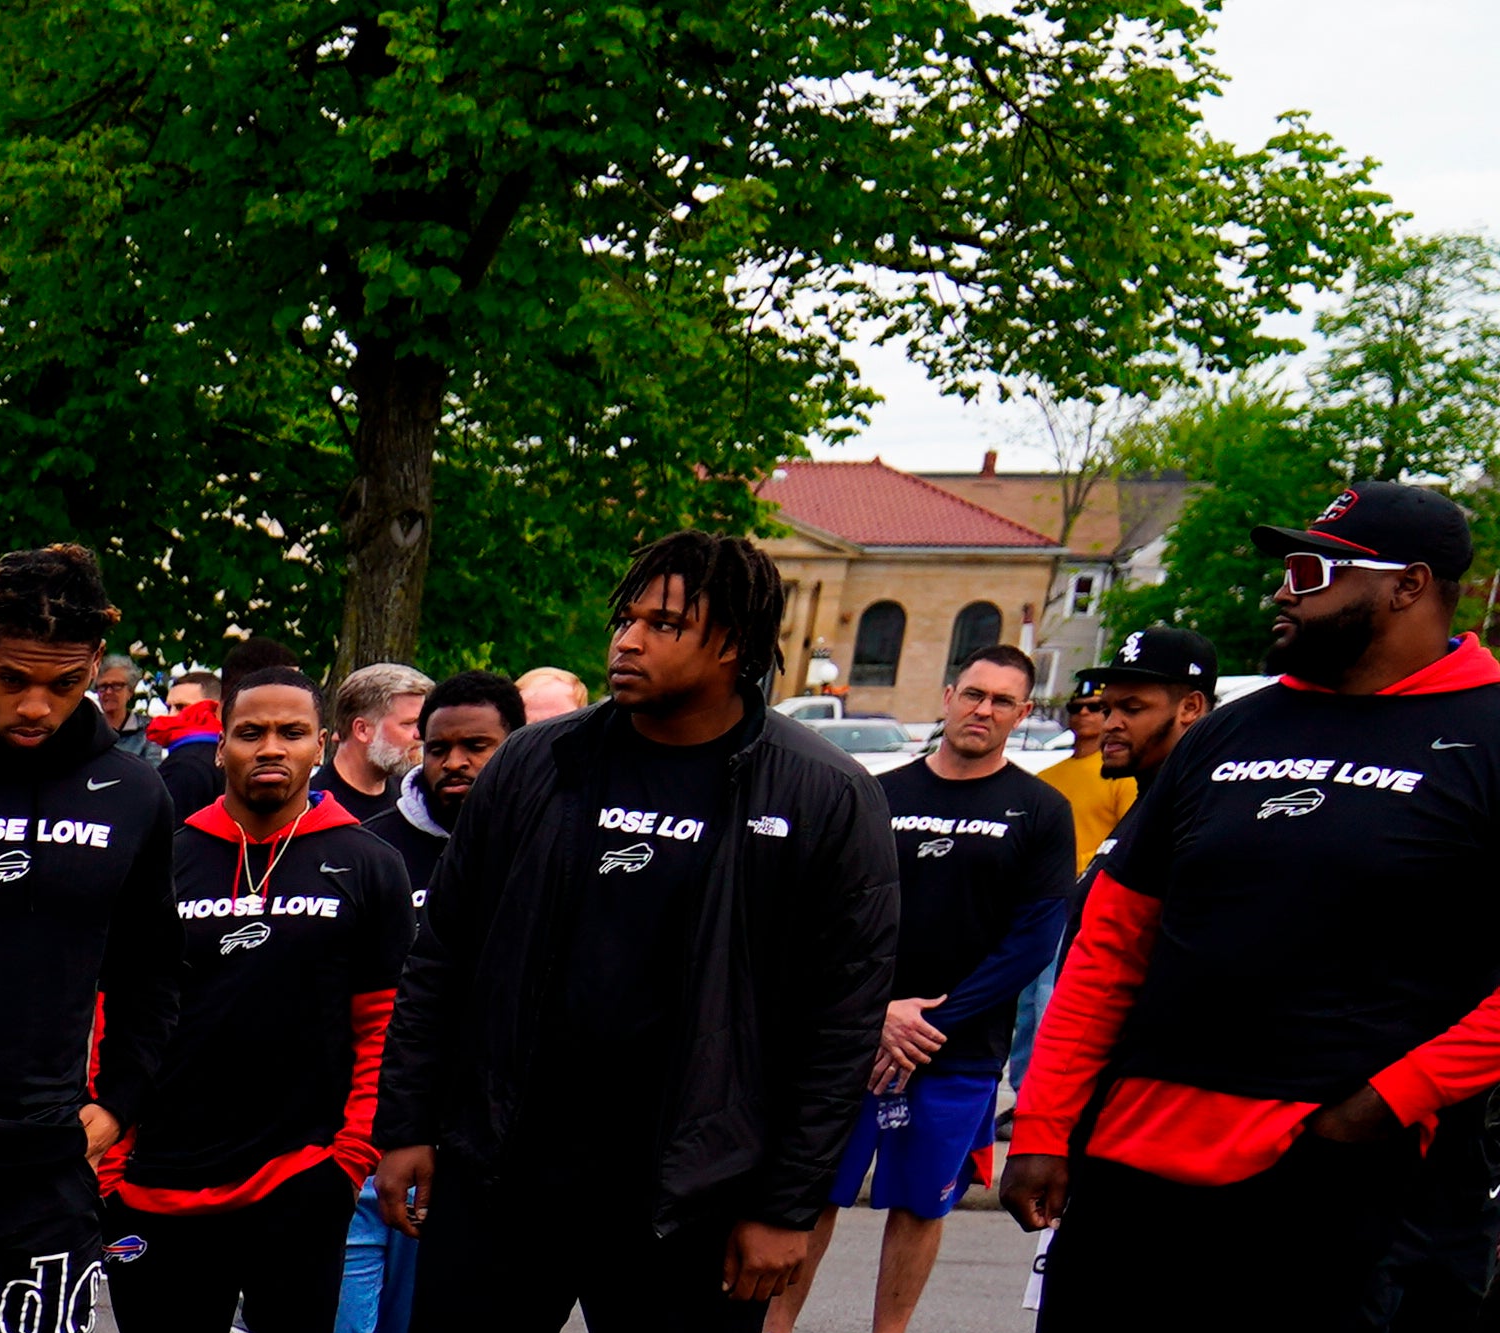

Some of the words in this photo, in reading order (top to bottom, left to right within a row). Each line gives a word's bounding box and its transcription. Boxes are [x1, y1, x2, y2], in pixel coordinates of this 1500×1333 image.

[1211, 758, 1335, 782] CHOOSE
[1333, 762, 1424, 793] LOVE
[36, 819, 111, 849] LOVE
[598, 807, 657, 833] OSE
[658, 815, 704, 843] LO
[891, 816, 955, 836] HOOSE
[956, 818, 1009, 839] LOVE
[177, 896, 264, 919] HOOSE
[270, 896, 340, 918] LOVE
